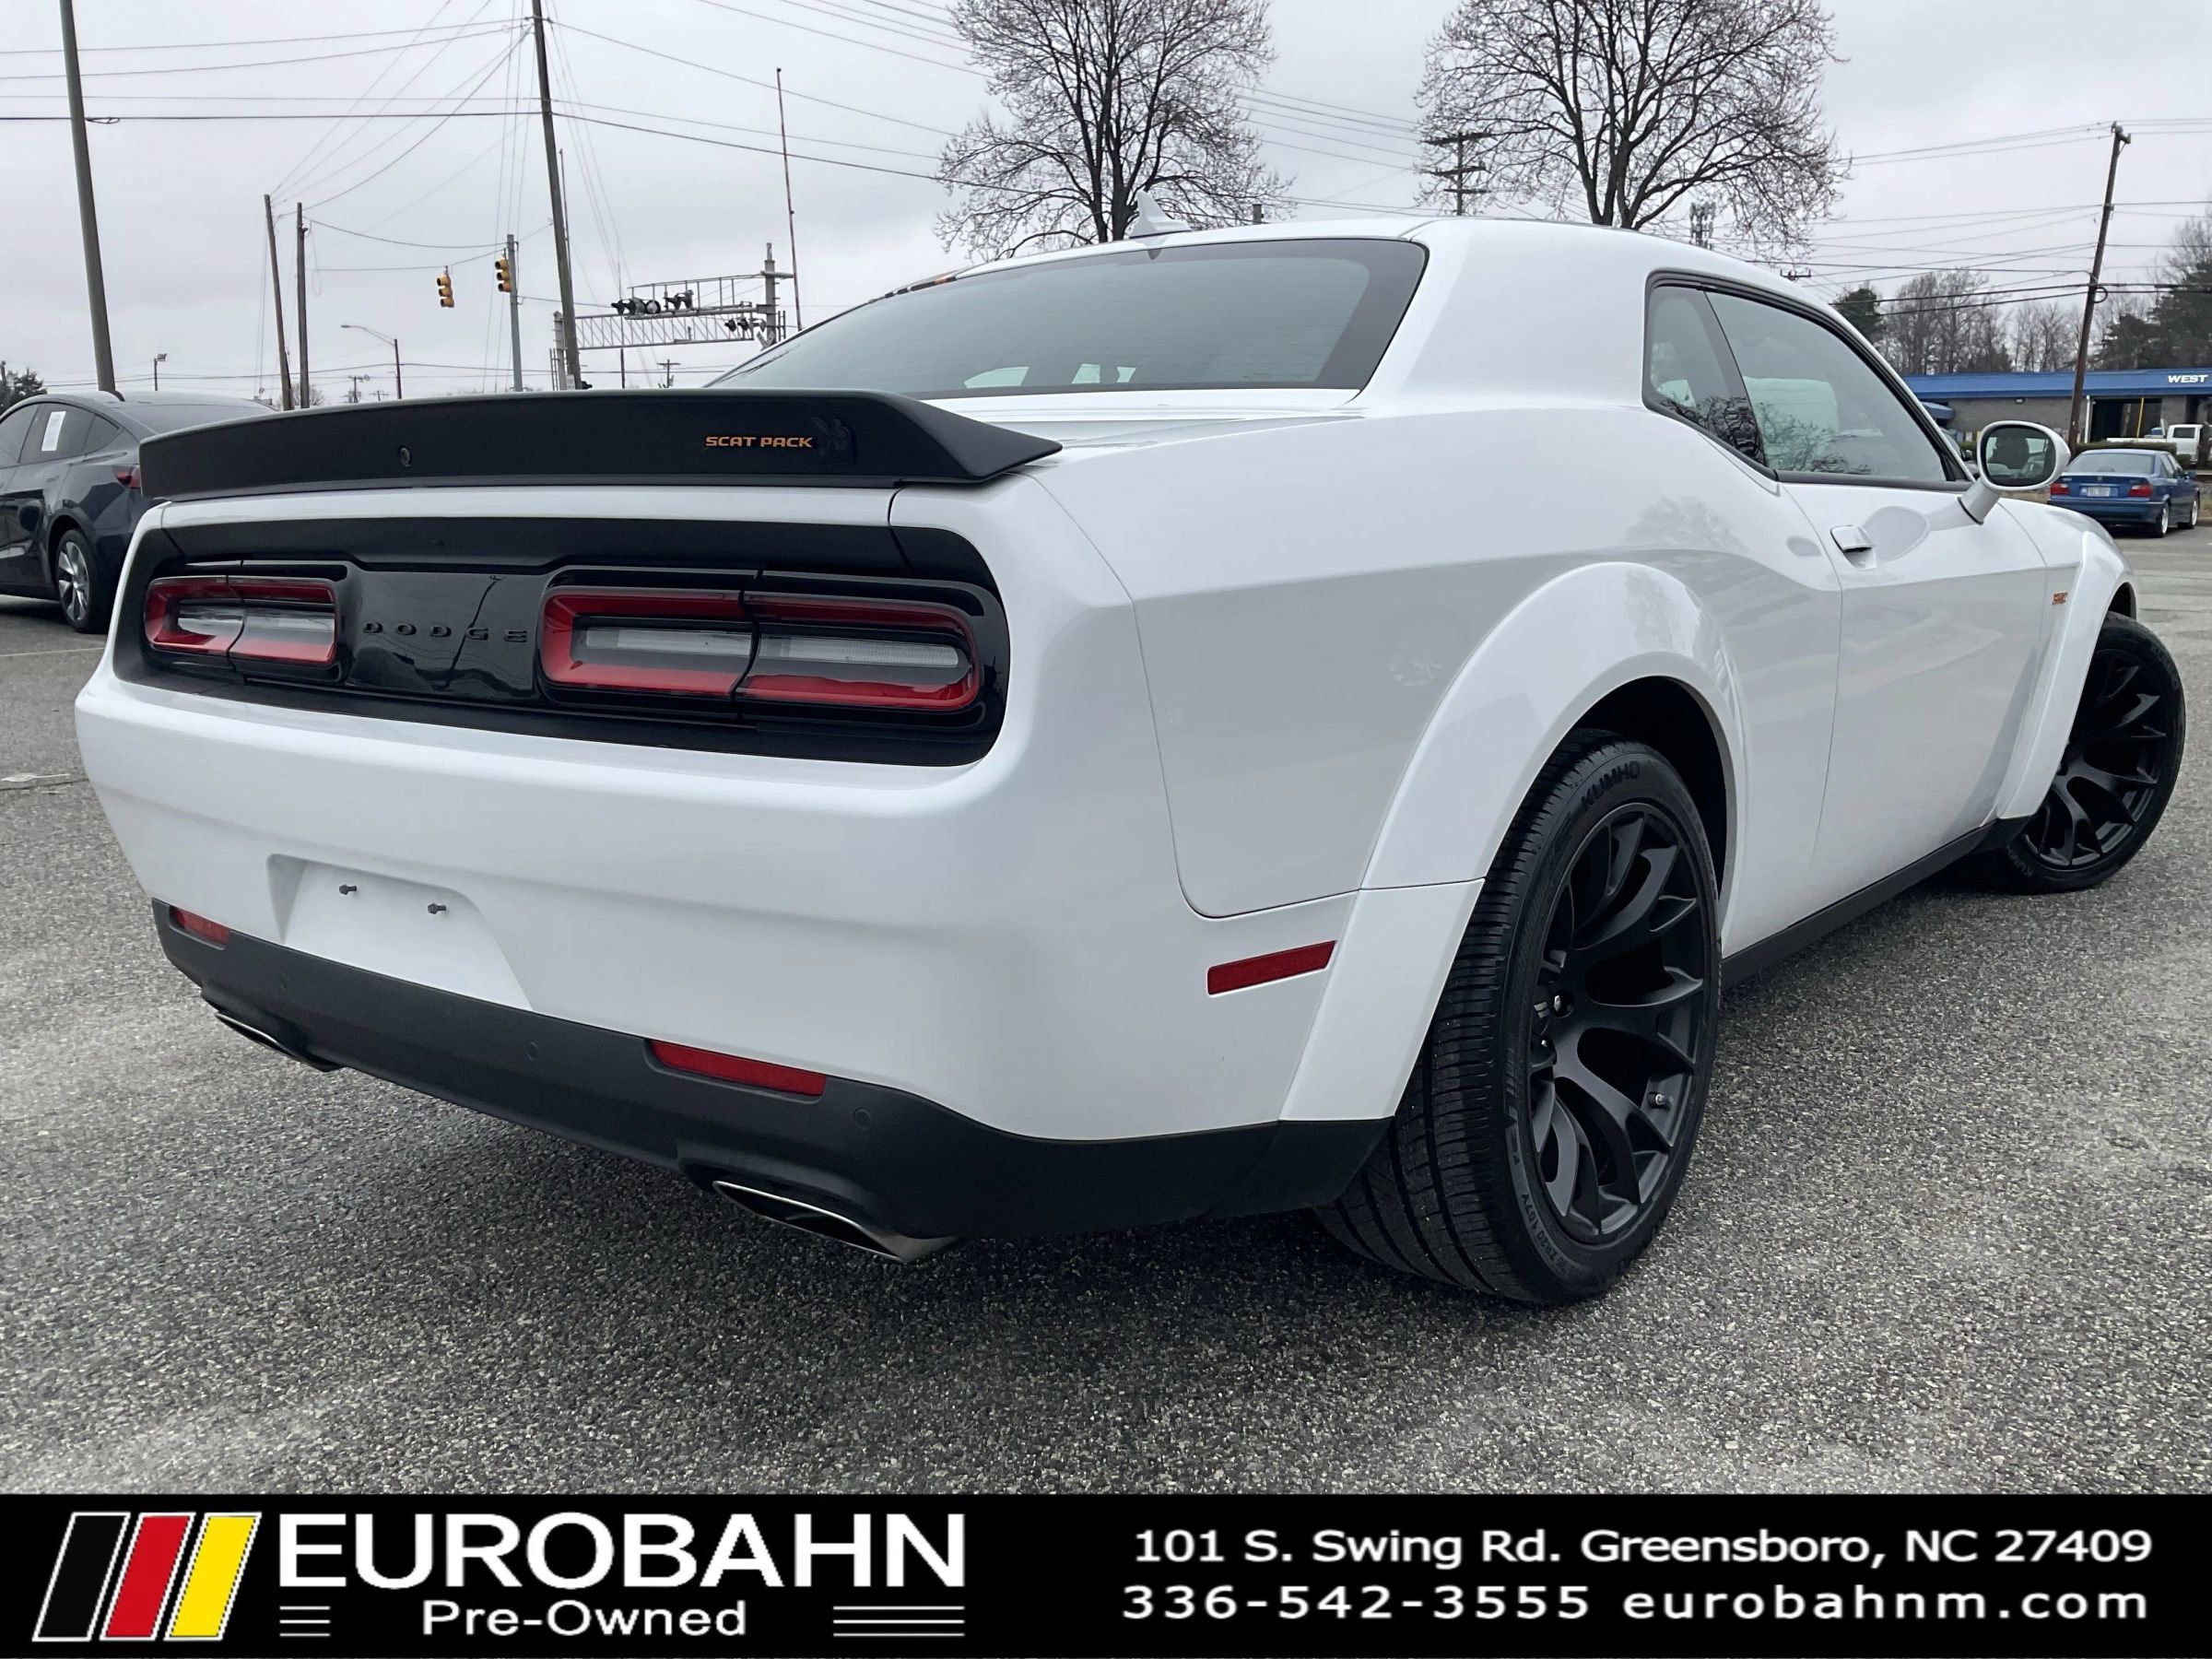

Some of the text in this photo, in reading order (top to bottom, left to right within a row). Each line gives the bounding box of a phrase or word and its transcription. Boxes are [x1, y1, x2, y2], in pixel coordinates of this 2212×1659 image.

[2168, 374, 2208, 383] WEST
[705, 436, 814, 448] SCAT PACK
[363, 622, 527, 643] DODGE
[1581, 760, 1641, 806] KUMHO
